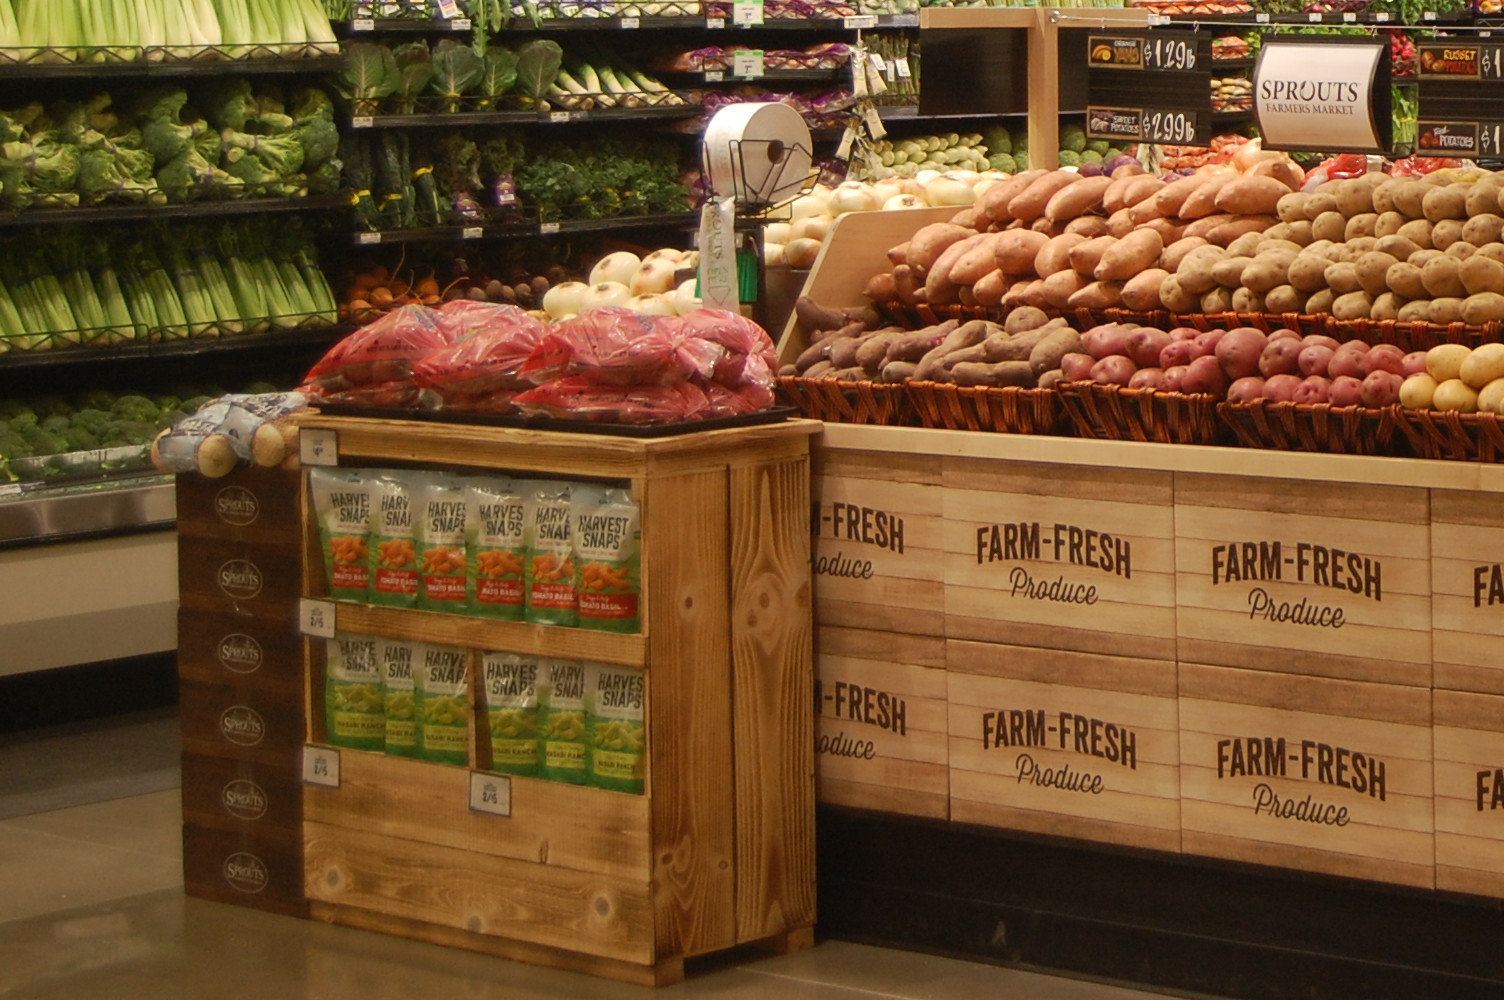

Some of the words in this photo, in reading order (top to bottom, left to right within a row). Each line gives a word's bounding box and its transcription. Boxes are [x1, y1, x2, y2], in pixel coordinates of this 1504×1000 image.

[1443, 49, 1477, 60] RUSSET
[1261, 80, 1359, 102] SPROUTS
[1266, 103, 1310, 114] FARMERS
[1312, 104, 1354, 115] MARKET
[1113, 115, 1136, 124] SWEET
[1440, 135, 1474, 148] POTATOES
[218, 497, 255, 512] SPROUTS
[578, 515, 629, 535] HARVEST
[583, 533, 620, 549] SNAPS
[976, 522, 1131, 580] FARM-FRESH
[222, 572, 259, 587] SPROUTS
[1212, 541, 1381, 601] FARM-FRESH
[1009, 566, 1098, 606] Produce
[1247, 588, 1346, 629] Produce
[222, 645, 259, 660] SPROUTS
[487, 663, 537, 680] HARVES
[493, 681, 534, 696] SNAPS
[598, 673, 643, 692] HARVES
[603, 691, 641, 709] SNAPS
[224, 718, 261, 733] SPROUTS
[814, 732, 876, 760] oduce
[982, 709, 1136, 770] FARM-FRESH
[1015, 753, 1104, 795] Produce
[1217, 737, 1386, 801] FARM-FRESH
[226, 791, 264, 807] SPROUTS
[1252, 783, 1350, 827] Produce
[227, 864, 265, 880] SPROUTS
